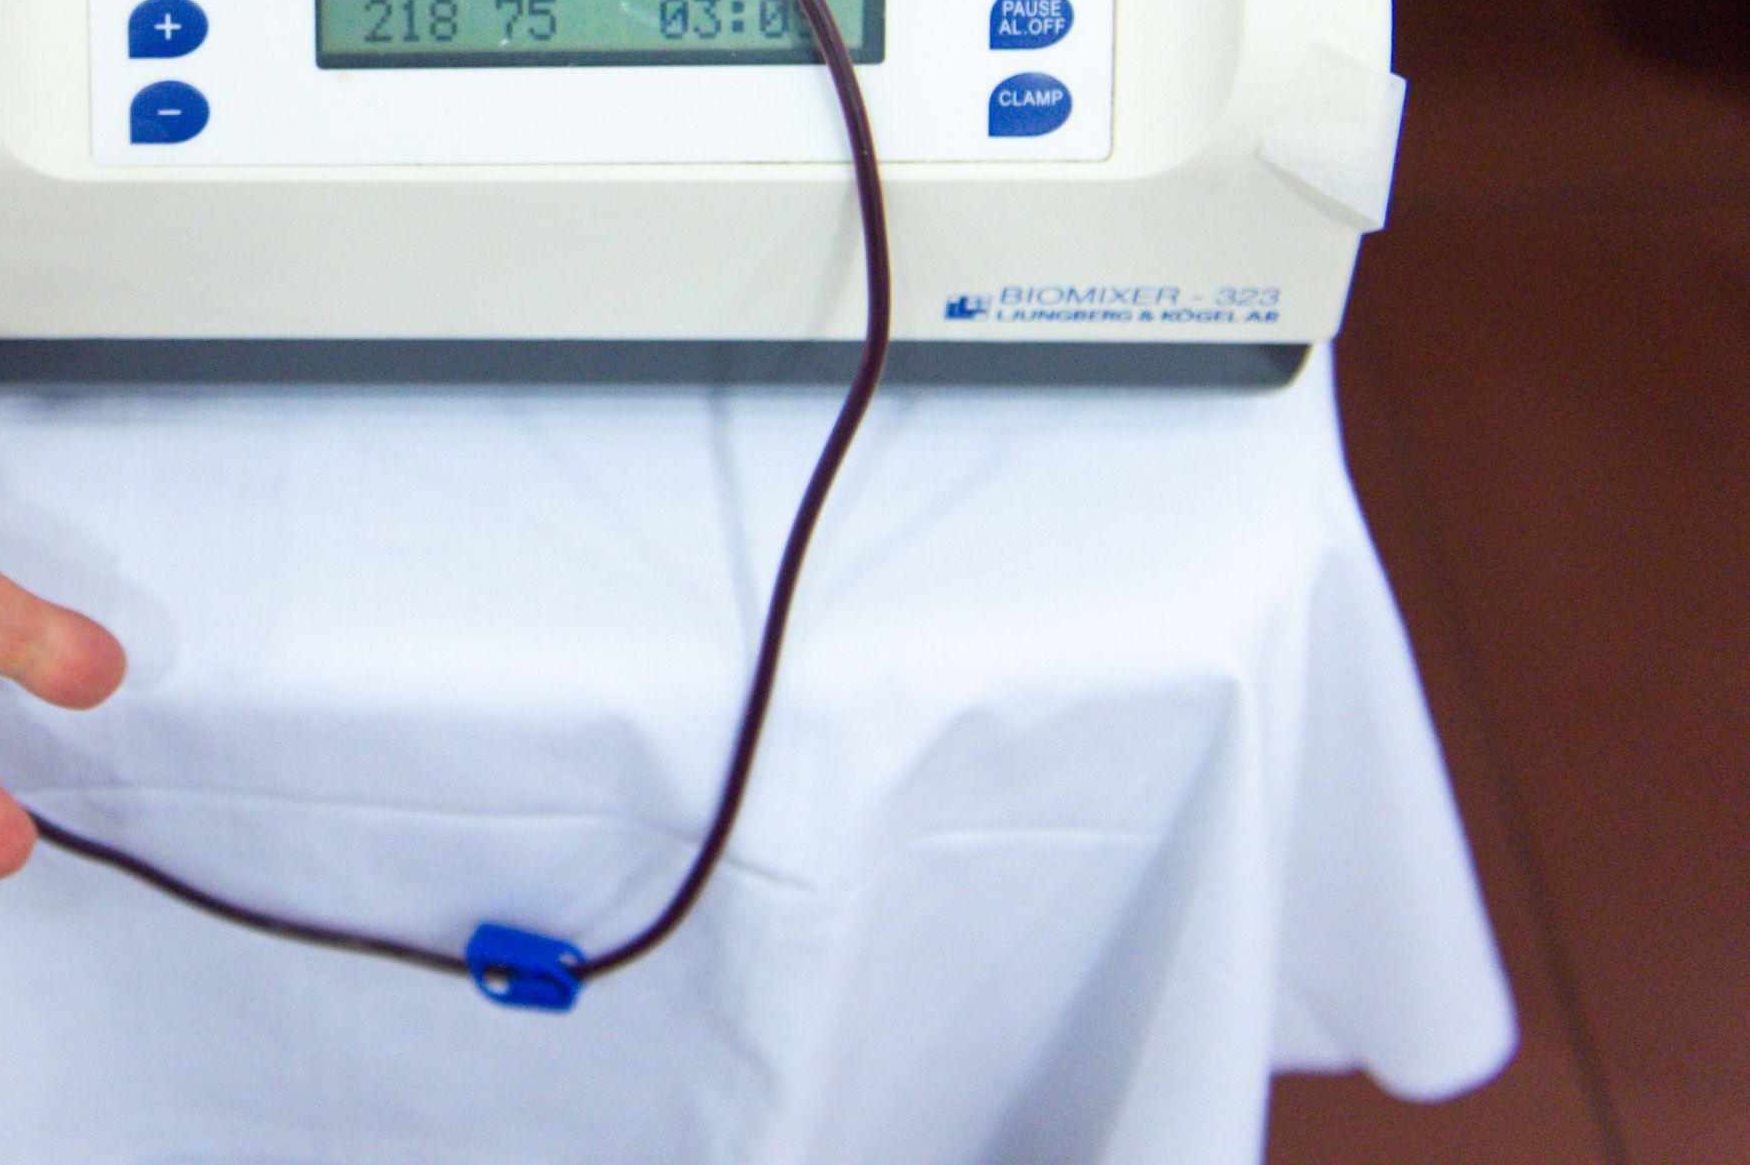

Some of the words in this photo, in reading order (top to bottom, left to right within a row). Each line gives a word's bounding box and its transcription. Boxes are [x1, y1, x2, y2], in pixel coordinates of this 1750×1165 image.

[1002, 0, 1063, 17] PAUSE
[998, 18, 1066, 36] AL.OFF
[998, 90, 1064, 107] CLAMP
[999, 285, 1180, 307] BIOMIXER
[1215, 285, 1280, 307] 323
[997, 308, 1133, 323] LJUNGBERG
[1245, 309, 1279, 323] AB
